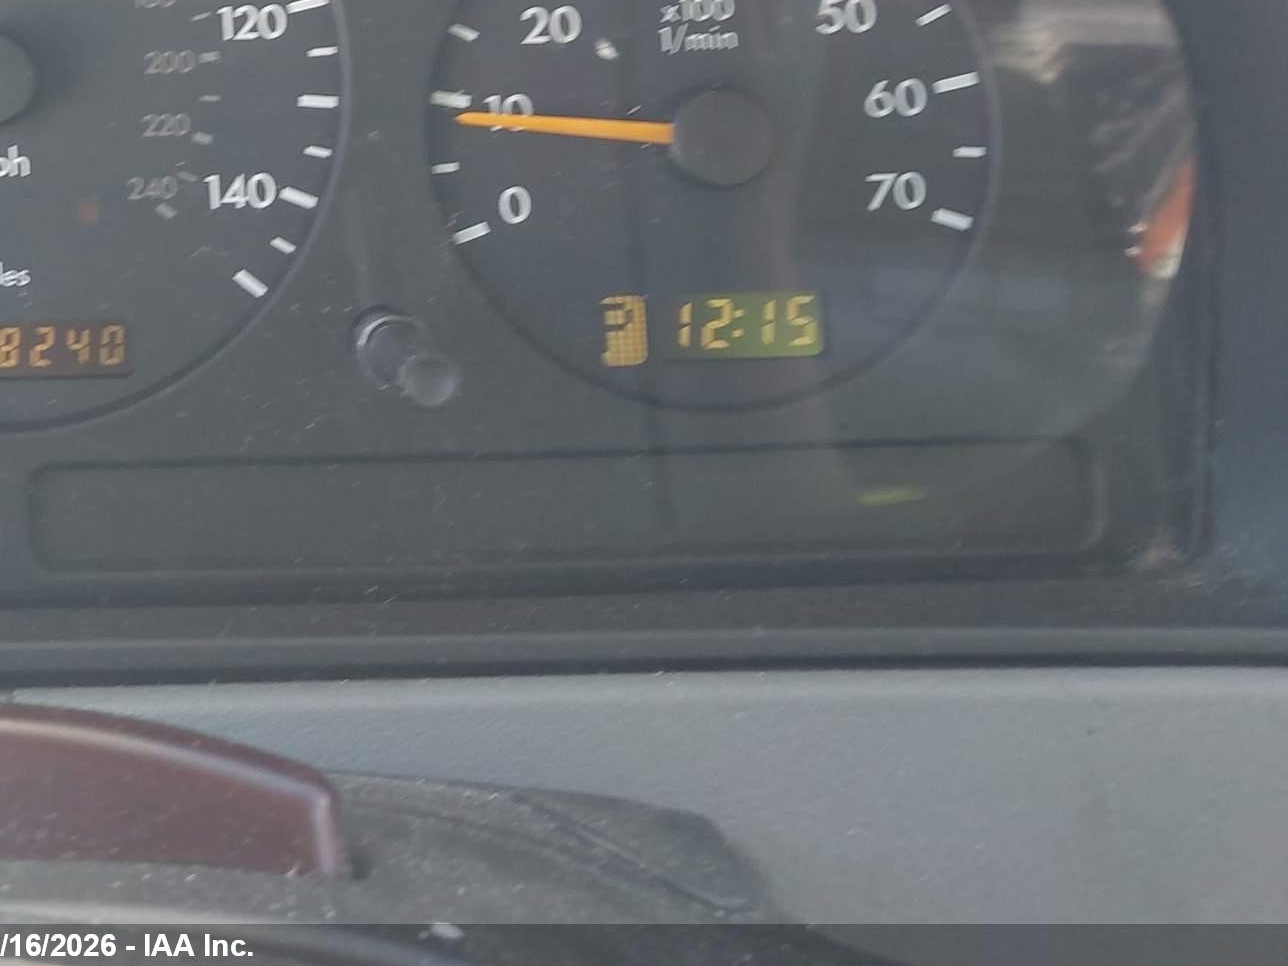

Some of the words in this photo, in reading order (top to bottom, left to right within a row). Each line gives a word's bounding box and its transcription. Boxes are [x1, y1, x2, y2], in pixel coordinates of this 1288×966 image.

[217, 5, 288, 41] 120
[520, 5, 582, 44] 20
[144, 50, 194, 75] 200
[864, 78, 928, 118] 60
[142, 113, 191, 137] 220
[128, 176, 178, 200] 240
[207, 173, 276, 210] 140
[498, 186, 531, 224] 0
[865, 171, 927, 211] 70
[678, 296, 816, 350] 12:15
